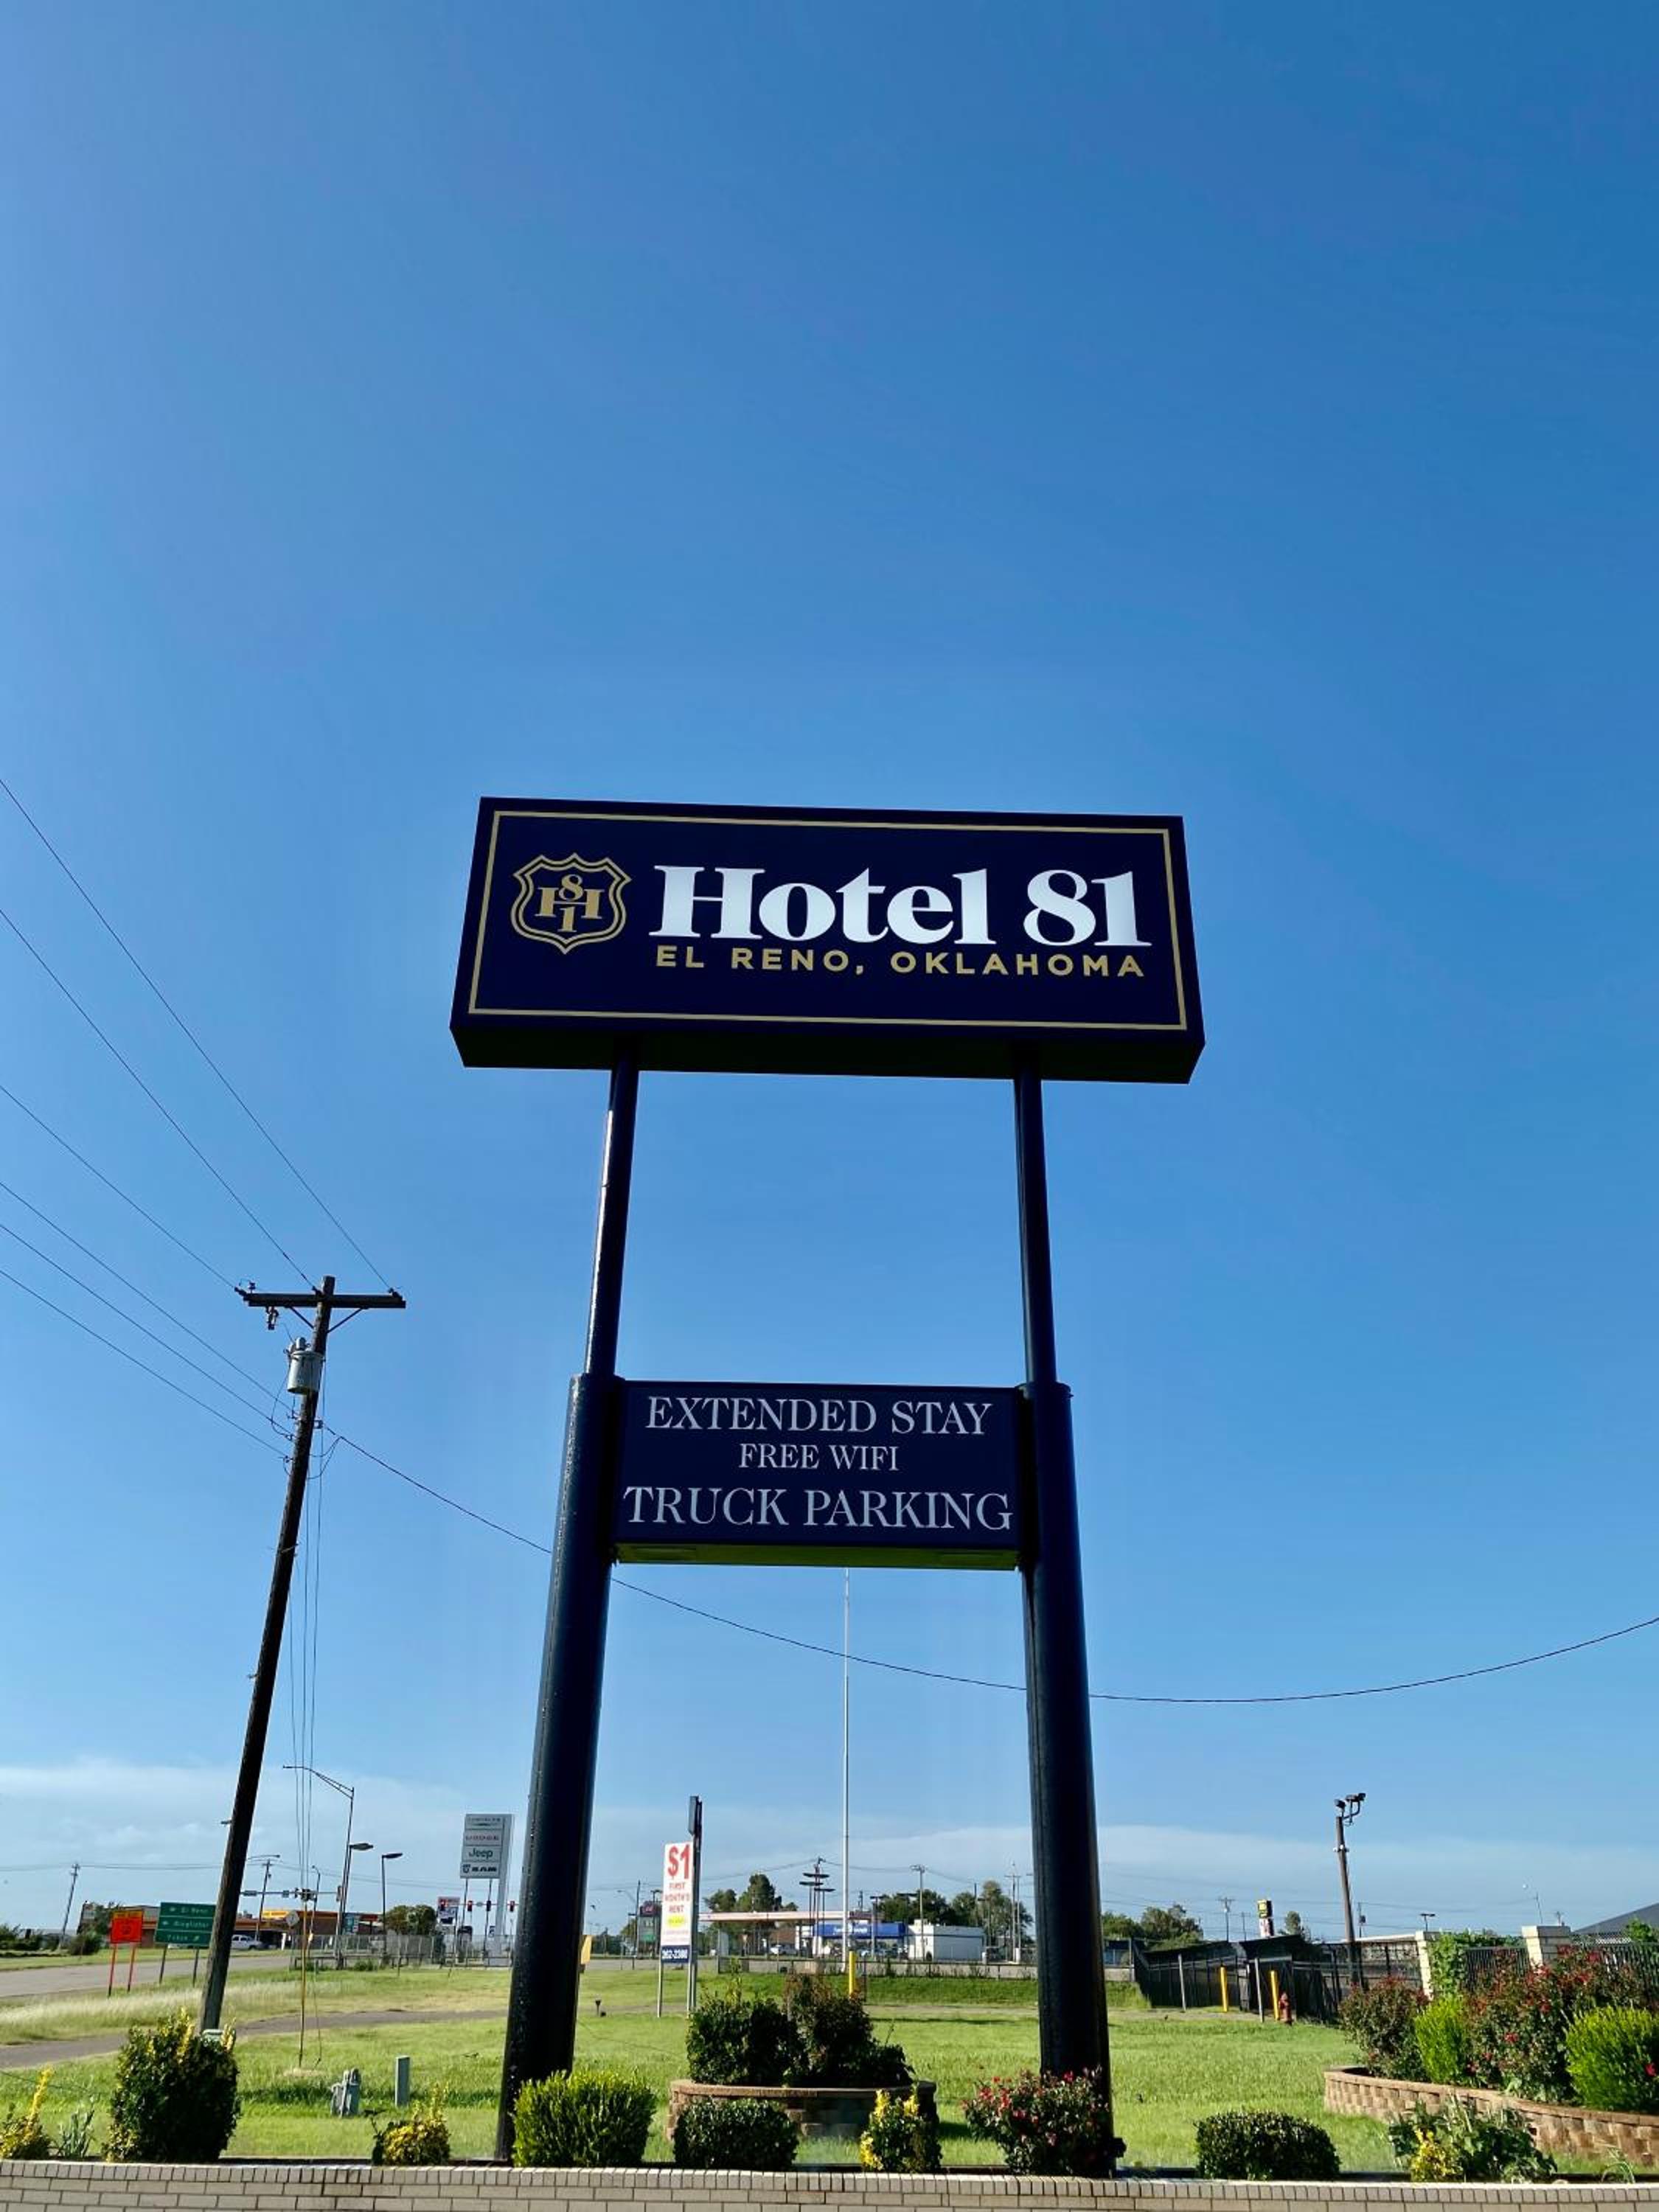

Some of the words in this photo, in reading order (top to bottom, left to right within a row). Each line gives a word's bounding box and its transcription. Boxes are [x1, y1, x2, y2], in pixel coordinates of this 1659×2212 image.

[648, 865, 997, 945] Hotel
[1023, 869, 1152, 947] 81
[656, 945, 705, 968] EL
[731, 947, 863, 975] RENO,
[890, 950, 1144, 977] OKLAHOMA
[645, 1396, 877, 1433] EXTENDED
[891, 1400, 992, 1435] STAY
[739, 1443, 819, 1470] FREE
[829, 1445, 899, 1471] WIFI
[623, 1486, 789, 1526] TRUCK
[803, 1489, 1014, 1530] PARKING
[468, 1847, 493, 1859] Jeep
[668, 1844, 689, 1880] $1
